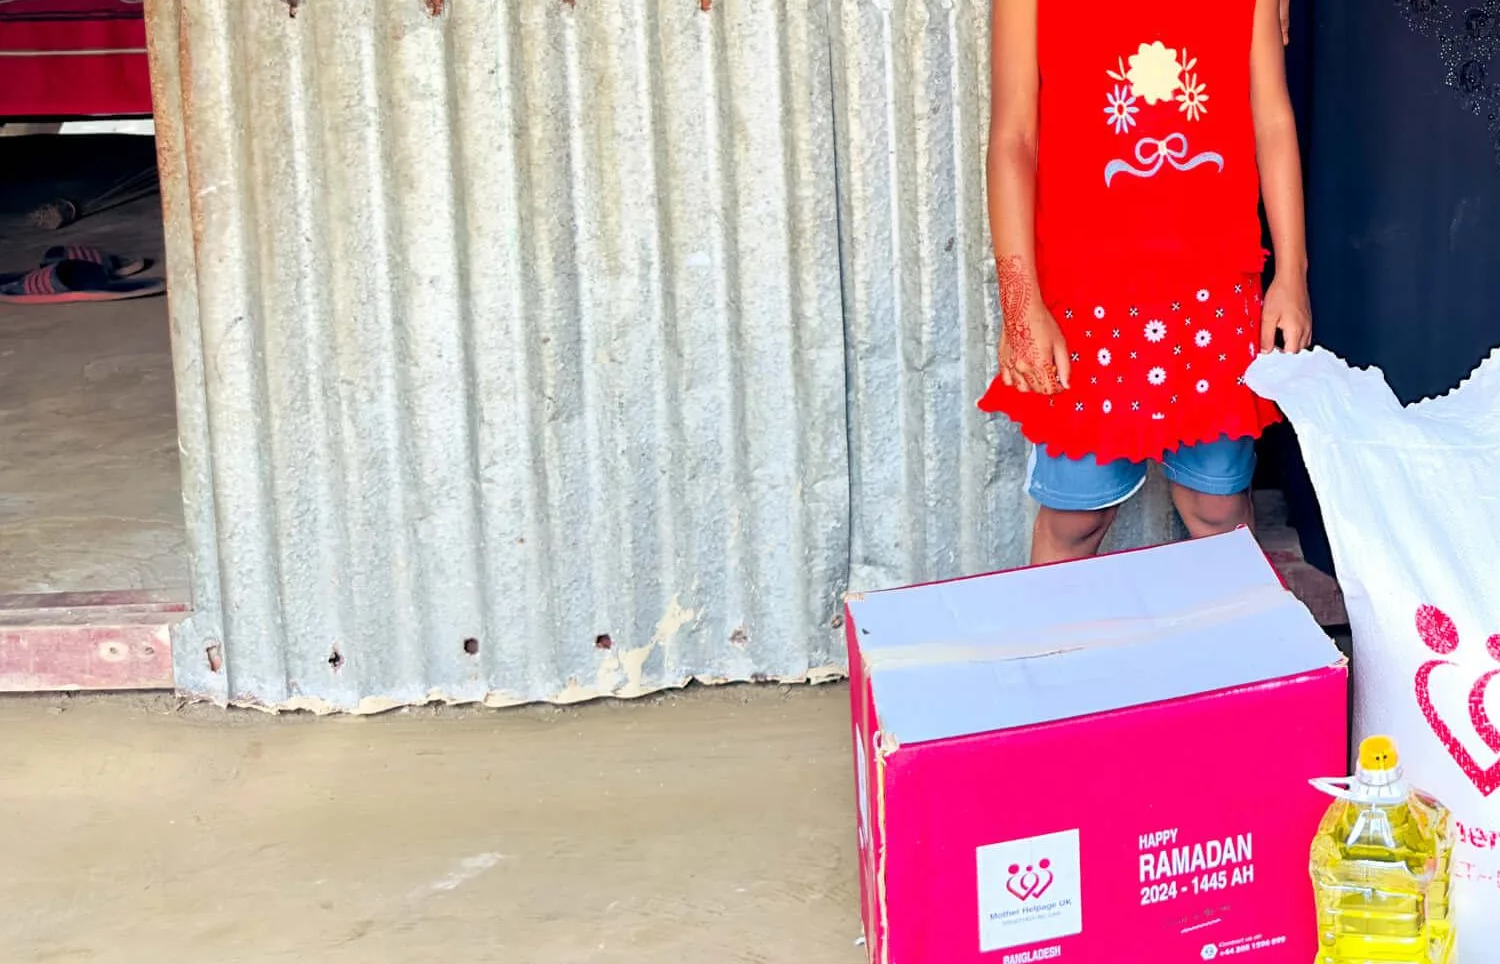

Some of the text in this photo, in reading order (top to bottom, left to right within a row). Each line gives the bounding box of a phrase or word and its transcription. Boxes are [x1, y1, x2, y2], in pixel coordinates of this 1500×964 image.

[1139, 827, 1178, 850] HAPPY
[1139, 832, 1253, 883] RAMADAN
[1140, 880, 1178, 906] 2024
[1191, 870, 1227, 894] 1445
[1231, 864, 1254, 887] AH
[1003, 945, 1061, 964] BANGLADESH
